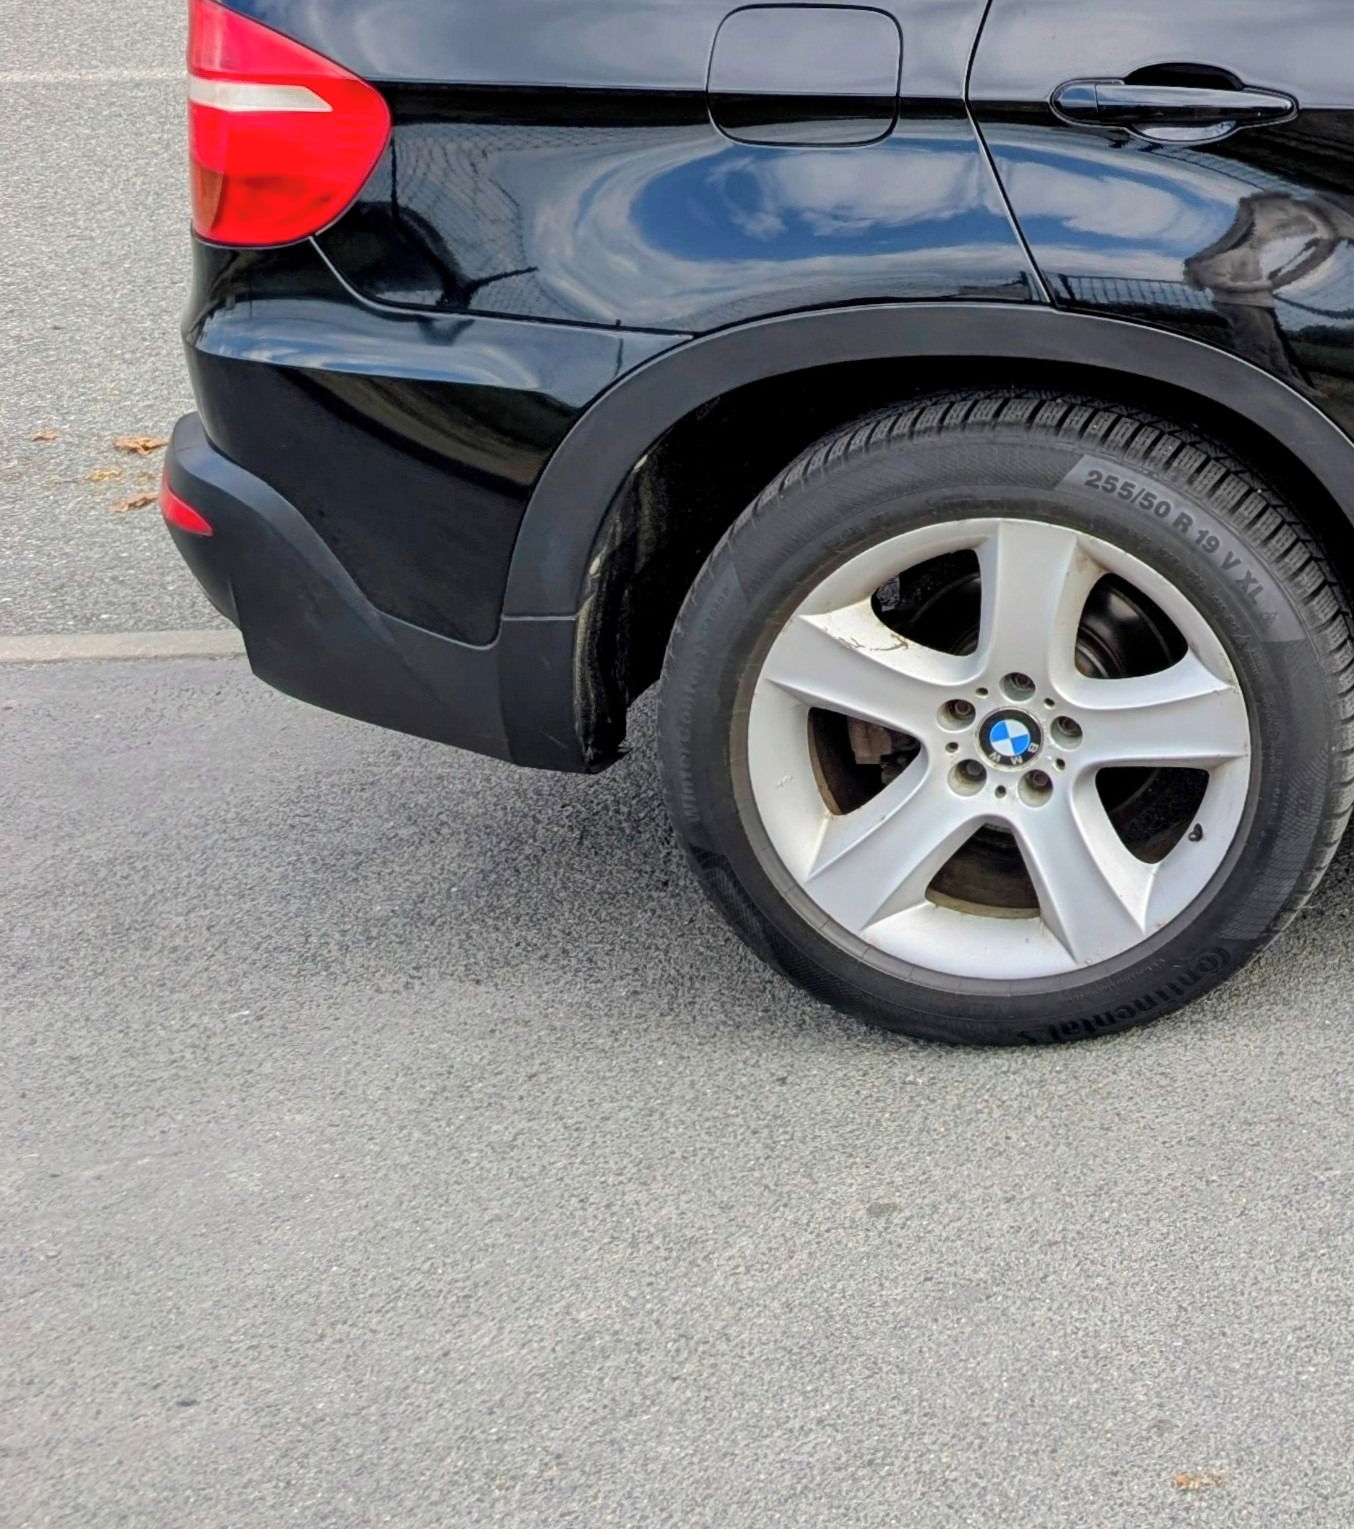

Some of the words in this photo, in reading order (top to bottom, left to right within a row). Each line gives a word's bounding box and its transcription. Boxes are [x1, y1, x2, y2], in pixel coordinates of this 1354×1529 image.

[1084, 469, 1171, 519] 255/50
[1172, 511, 1194, 535] R
[1194, 529, 1220, 554] 19
[1220, 551, 1243, 571] V
[1235, 571, 1264, 605] XL
